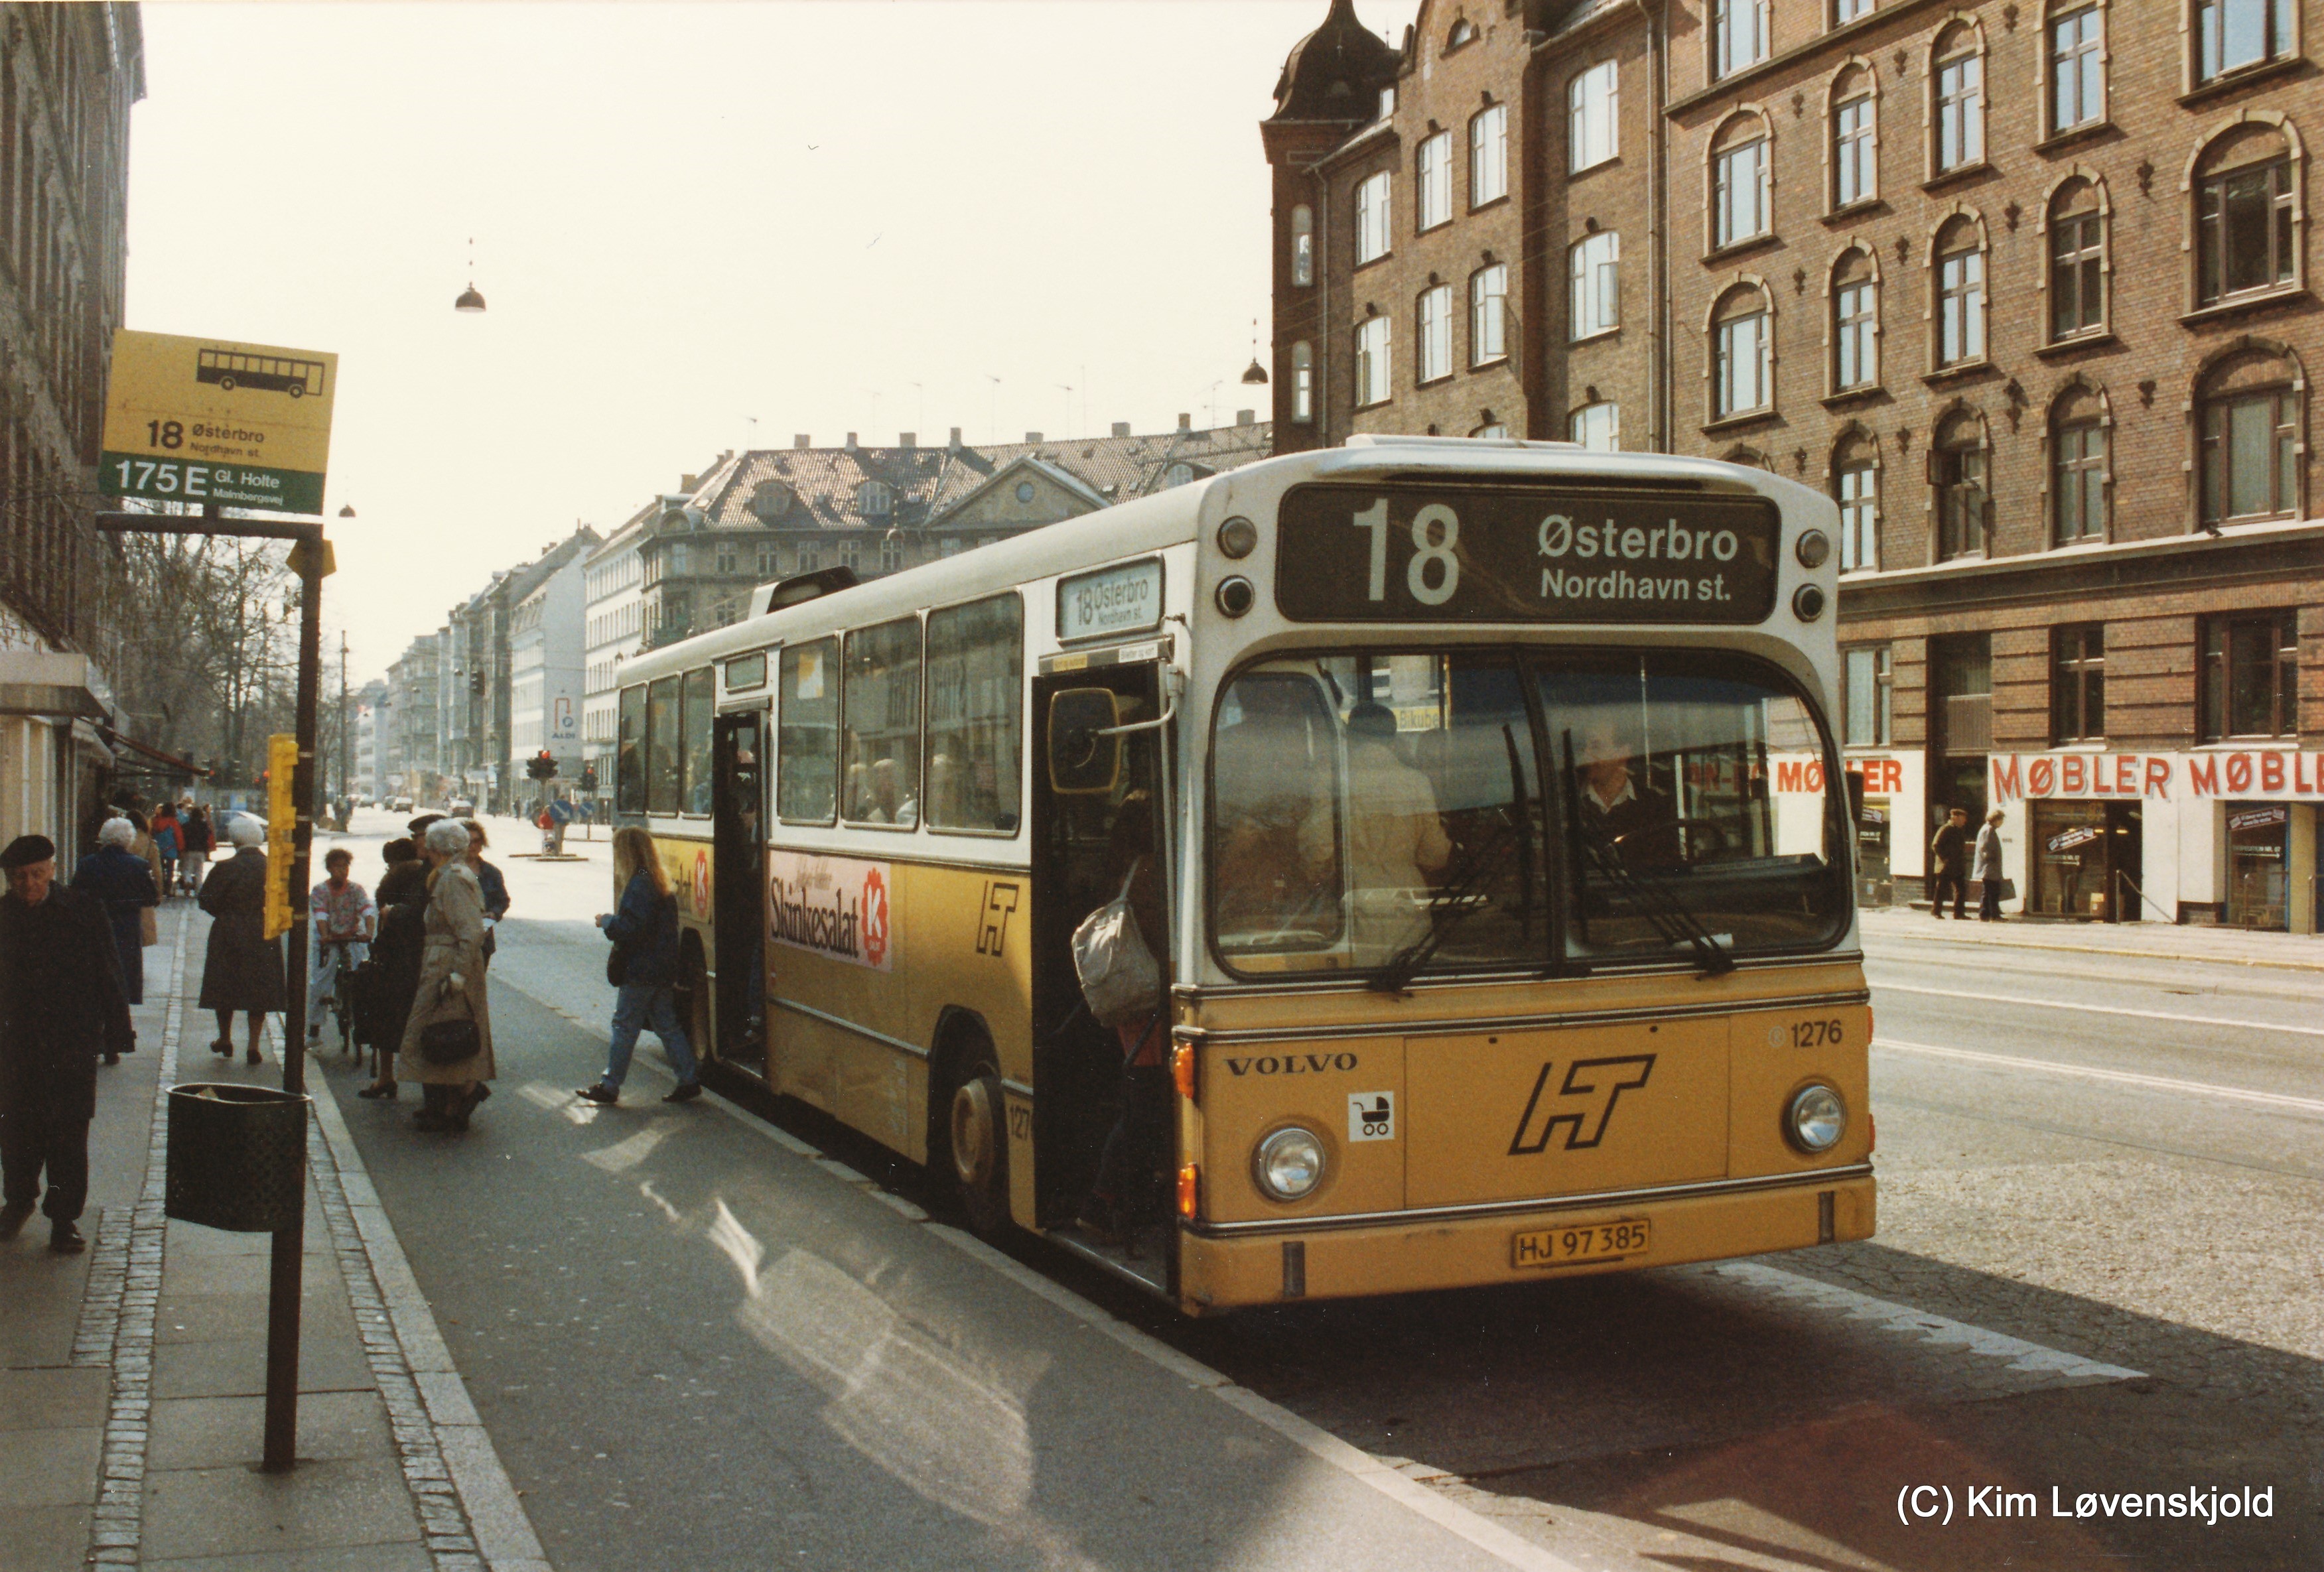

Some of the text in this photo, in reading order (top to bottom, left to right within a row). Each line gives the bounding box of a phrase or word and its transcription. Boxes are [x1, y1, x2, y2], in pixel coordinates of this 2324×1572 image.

[147, 420, 265, 449] 18 Østerbro
[190, 442, 243, 456] Nordhavn
[215, 469, 234, 484] Gl.
[241, 472, 281, 489] Holte
[1353, 497, 1738, 606] 18 Østerbro
[1540, 568, 1731, 601] Nordhavn st.
[1076, 587, 1093, 626] 18
[1777, 760, 1902, 793] MØER
[1992, 753, 2171, 803] MØBLER
[2189, 752, 2324, 796] MØBL
[771, 876, 859, 958] Skinkesalat
[866, 884, 882, 939] K
[1792, 1019, 1843, 1048] 1276
[1224, 1052, 1357, 1076] VOLVO
[1507, 1053, 1657, 1156] HT
[1519, 1224, 1645, 1261] HJ 97 385
